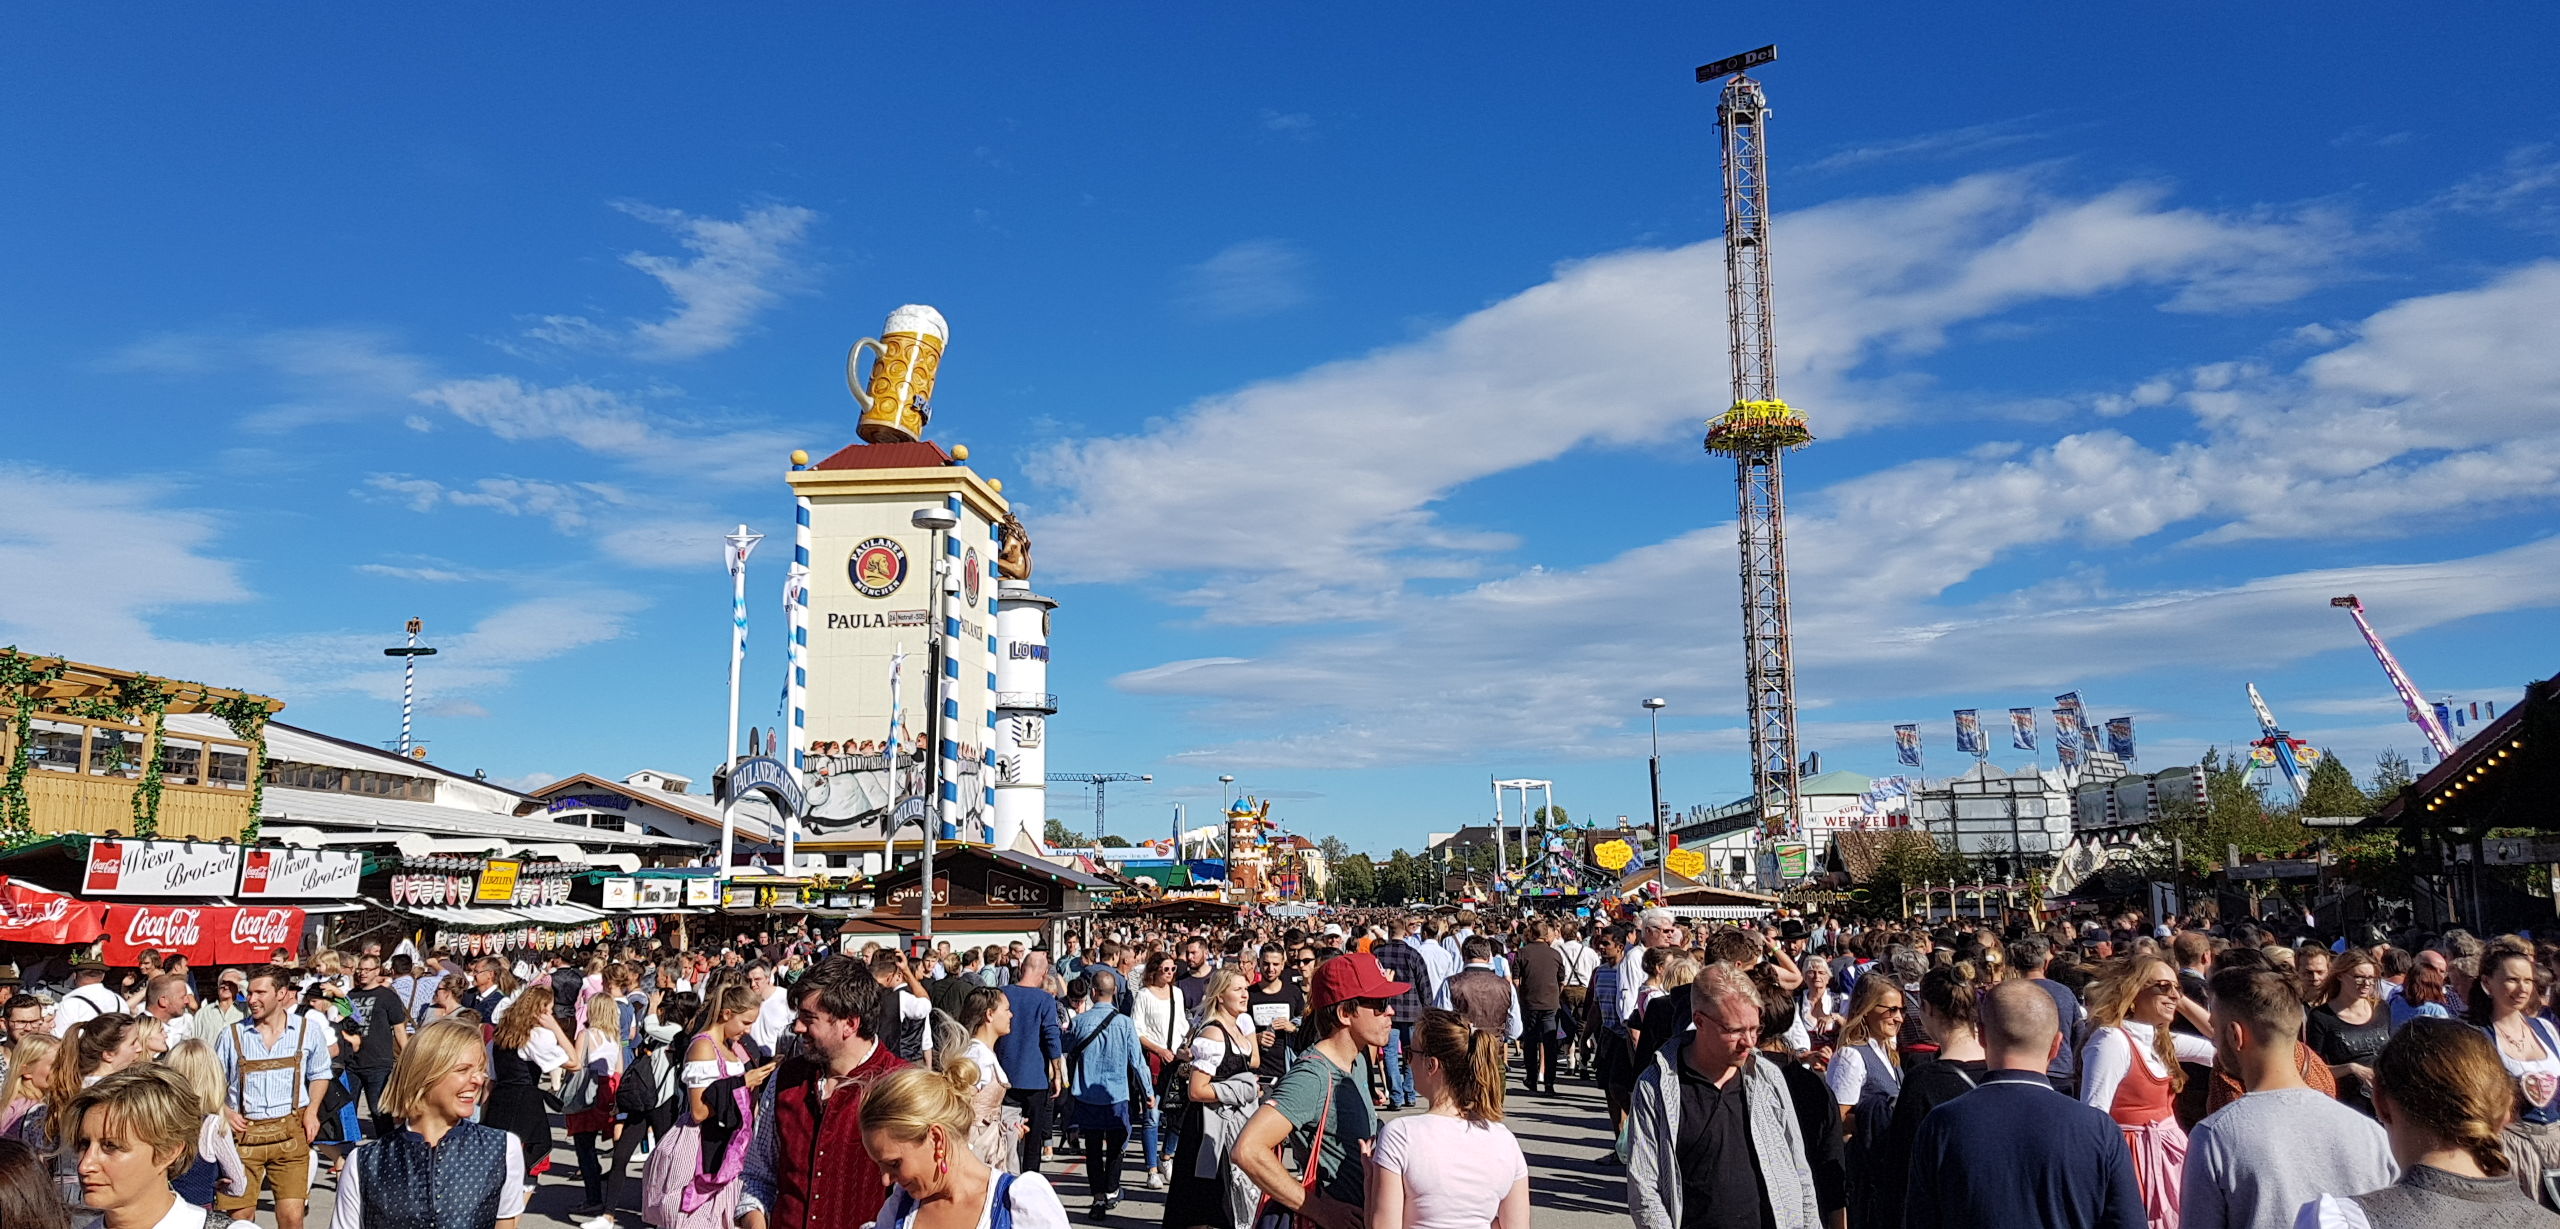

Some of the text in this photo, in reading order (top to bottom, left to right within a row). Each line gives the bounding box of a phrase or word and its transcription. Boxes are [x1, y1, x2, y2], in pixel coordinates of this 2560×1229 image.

[851, 538, 905, 561] PAULANER
[827, 613, 926, 628] PAULA
[733, 761, 802, 814] PAULANERGARTEN
[122, 848, 174, 877] Wiesn
[164, 851, 236, 890] Brotzeit
[270, 857, 310, 881] Wiesn
[300, 858, 359, 893] Brotzeit
[992, 885, 1041, 902] Ecke
